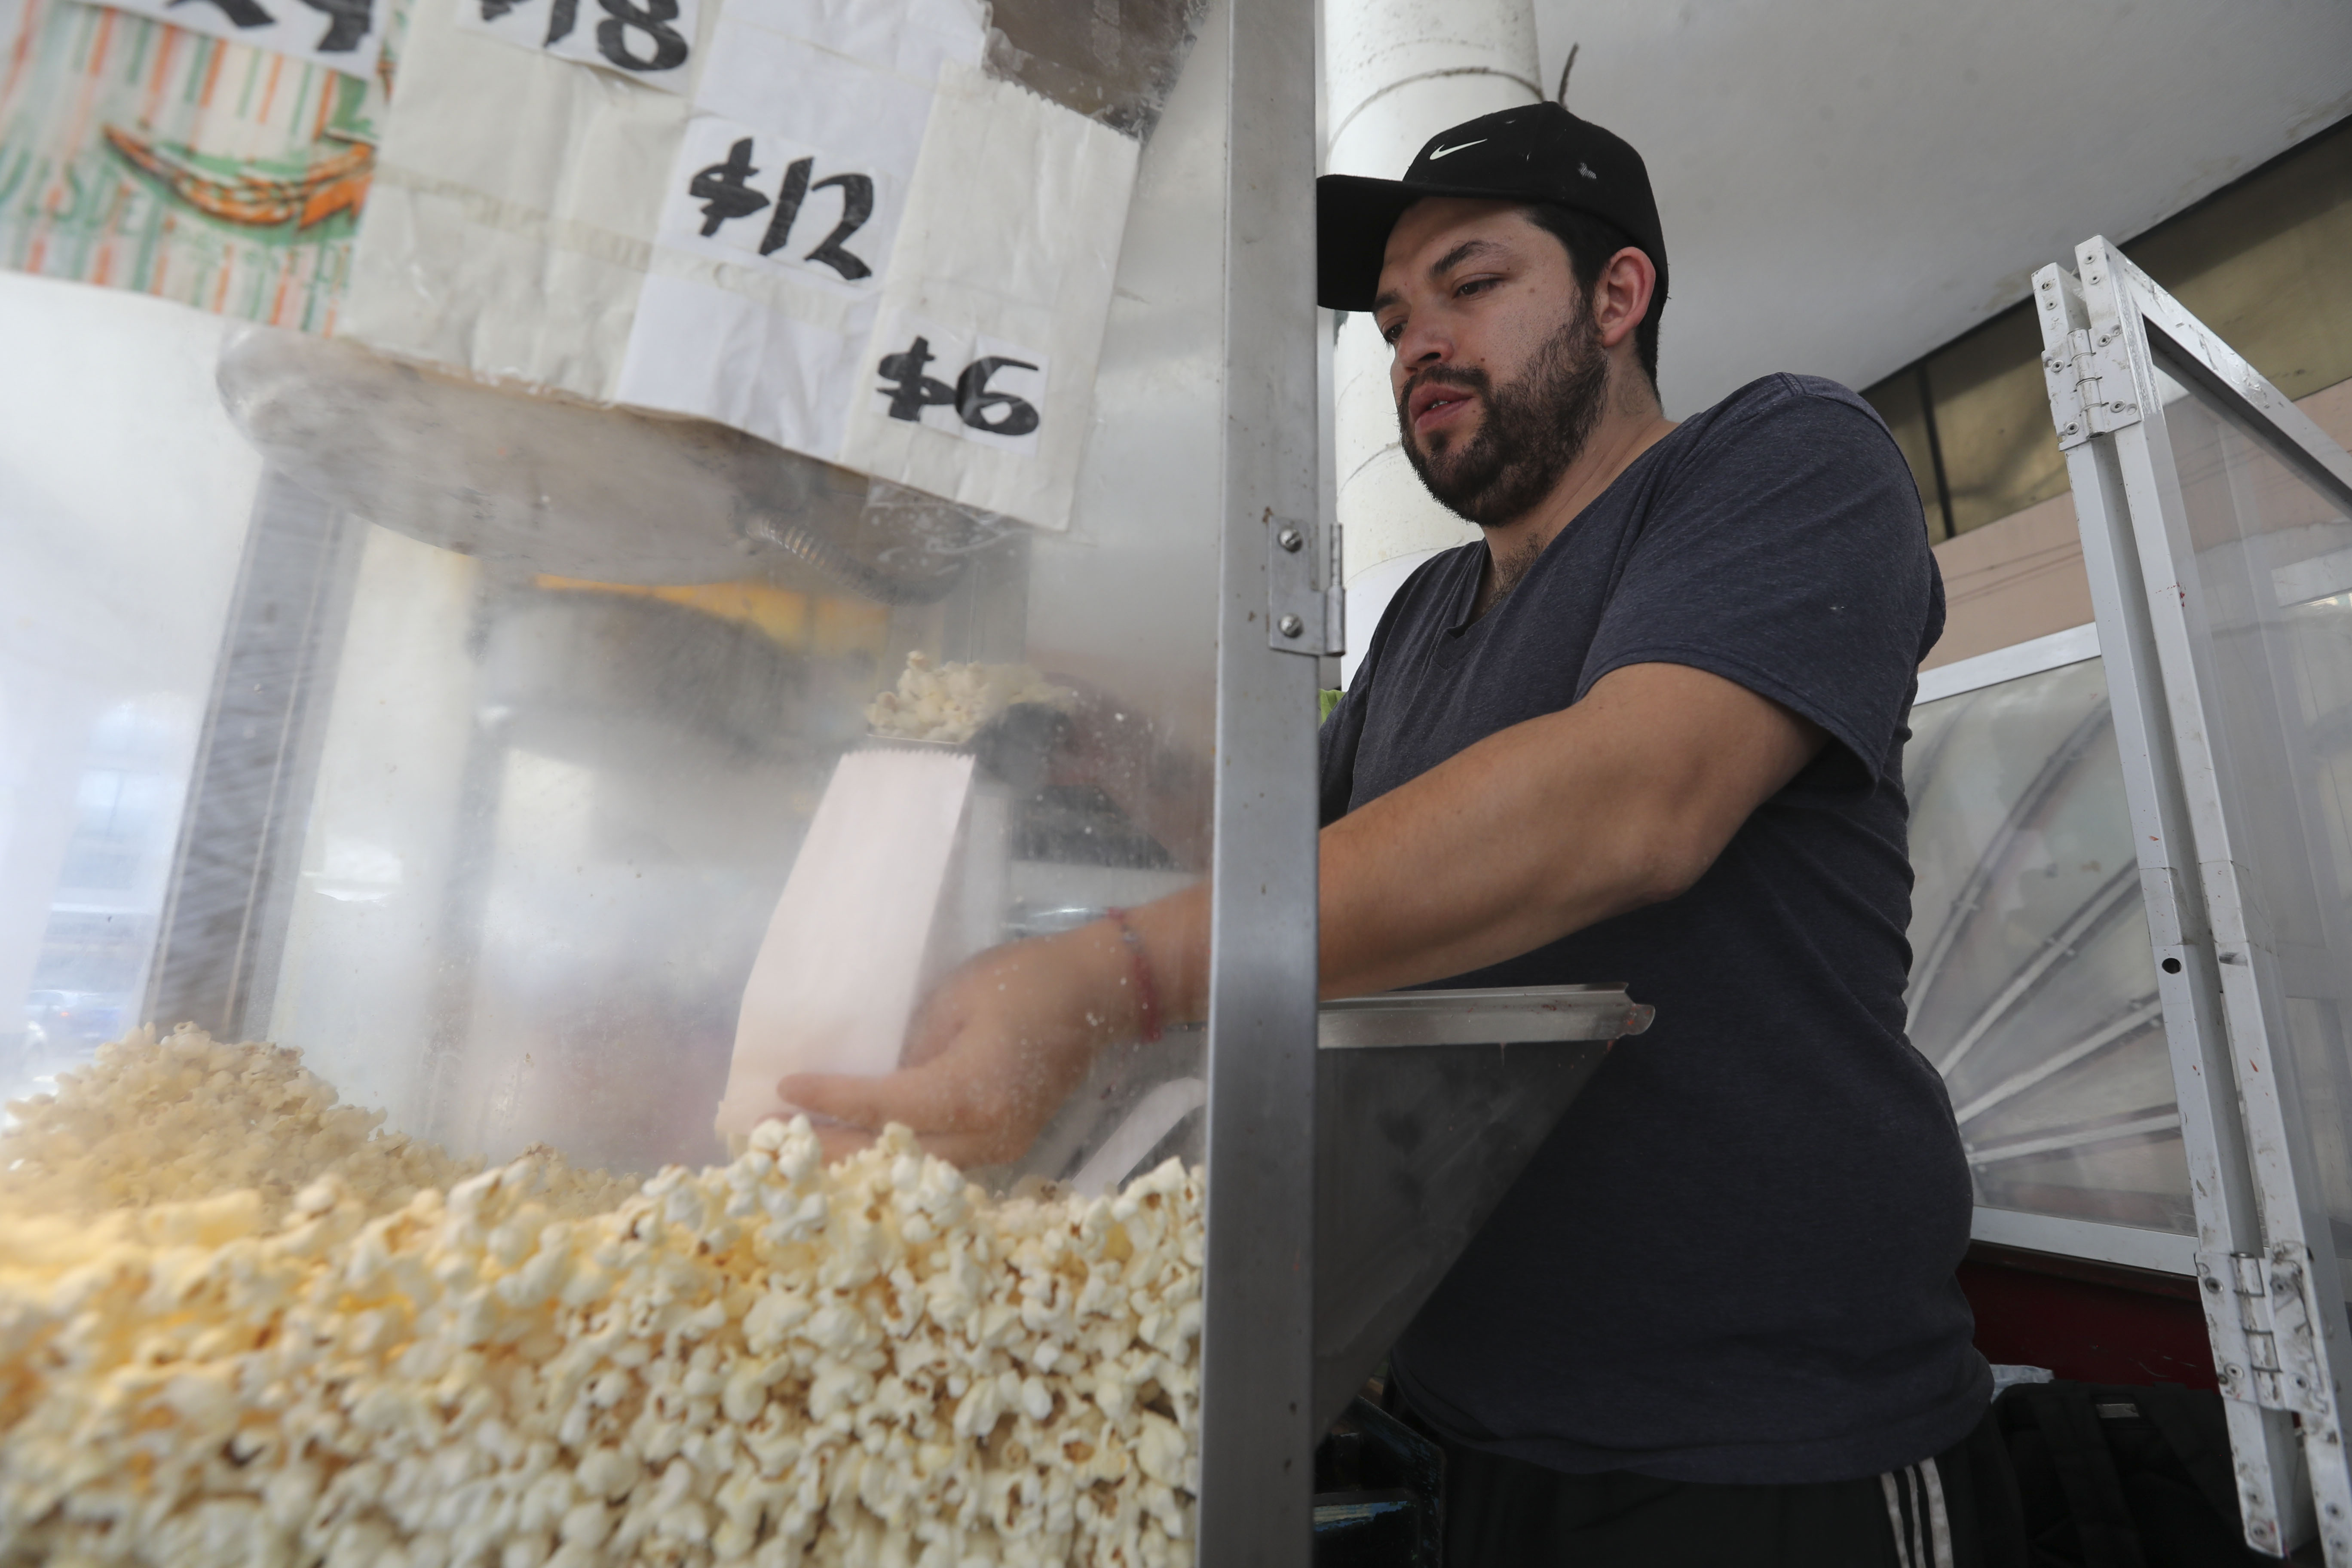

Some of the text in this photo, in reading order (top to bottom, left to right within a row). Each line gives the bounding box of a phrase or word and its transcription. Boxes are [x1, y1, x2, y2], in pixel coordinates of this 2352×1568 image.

[481, 0, 689, 72] 18
[689, 137, 874, 282] $12
[876, 335, 1040, 436] $6
